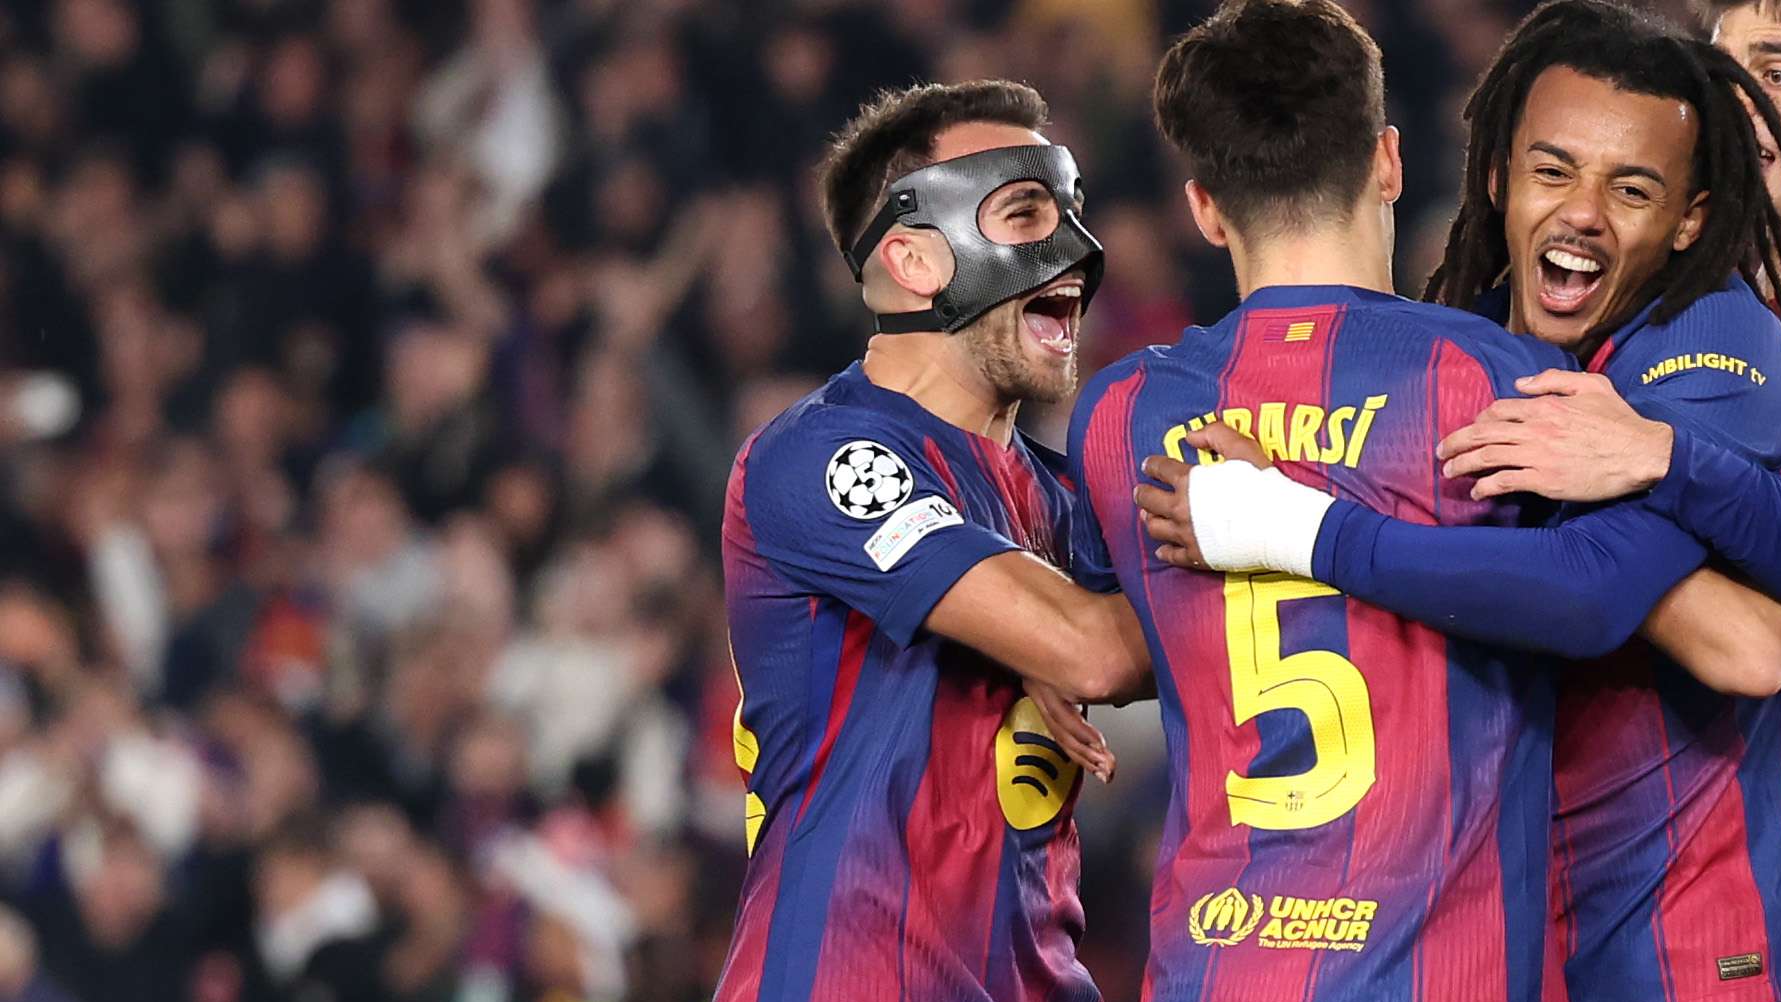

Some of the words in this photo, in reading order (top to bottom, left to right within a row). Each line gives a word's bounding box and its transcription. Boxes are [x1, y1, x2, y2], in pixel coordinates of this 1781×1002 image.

[1224, 570, 1377, 831] 5
[1270, 896, 1378, 920] UNHCR
[1259, 918, 1370, 941] ACNUR
